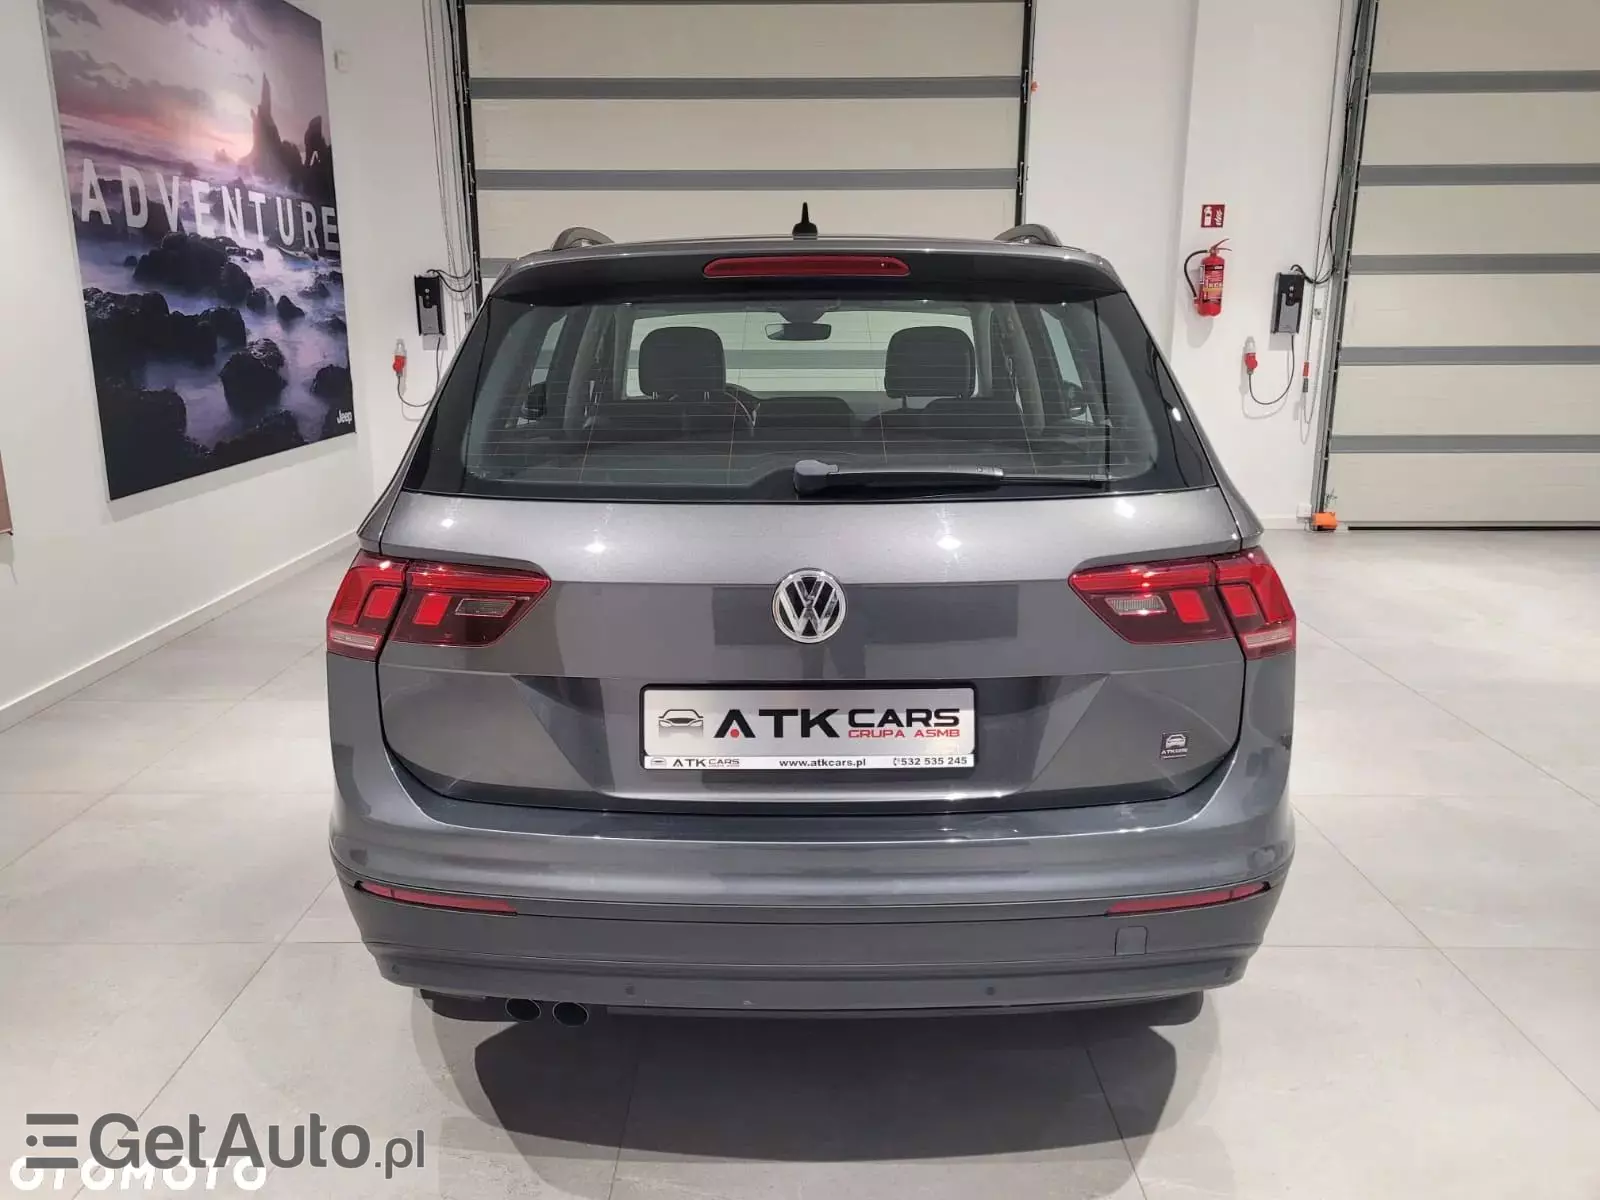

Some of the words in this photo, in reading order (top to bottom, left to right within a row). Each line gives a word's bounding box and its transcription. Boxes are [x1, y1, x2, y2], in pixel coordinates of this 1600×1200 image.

[80, 158, 339, 251] ADVENTURE
[336, 409, 353, 425] Jeep
[714, 708, 840, 738] ATK
[848, 708, 960, 727] CARS
[848, 729, 905, 738] GRUPA
[914, 729, 960, 738] ASMB
[672, 758, 706, 767] ATK
[779, 758, 866, 768] www.atkcars.pl
[901, 757, 921, 766] 532
[924, 757, 944, 766] 535
[947, 756, 968, 765] 245
